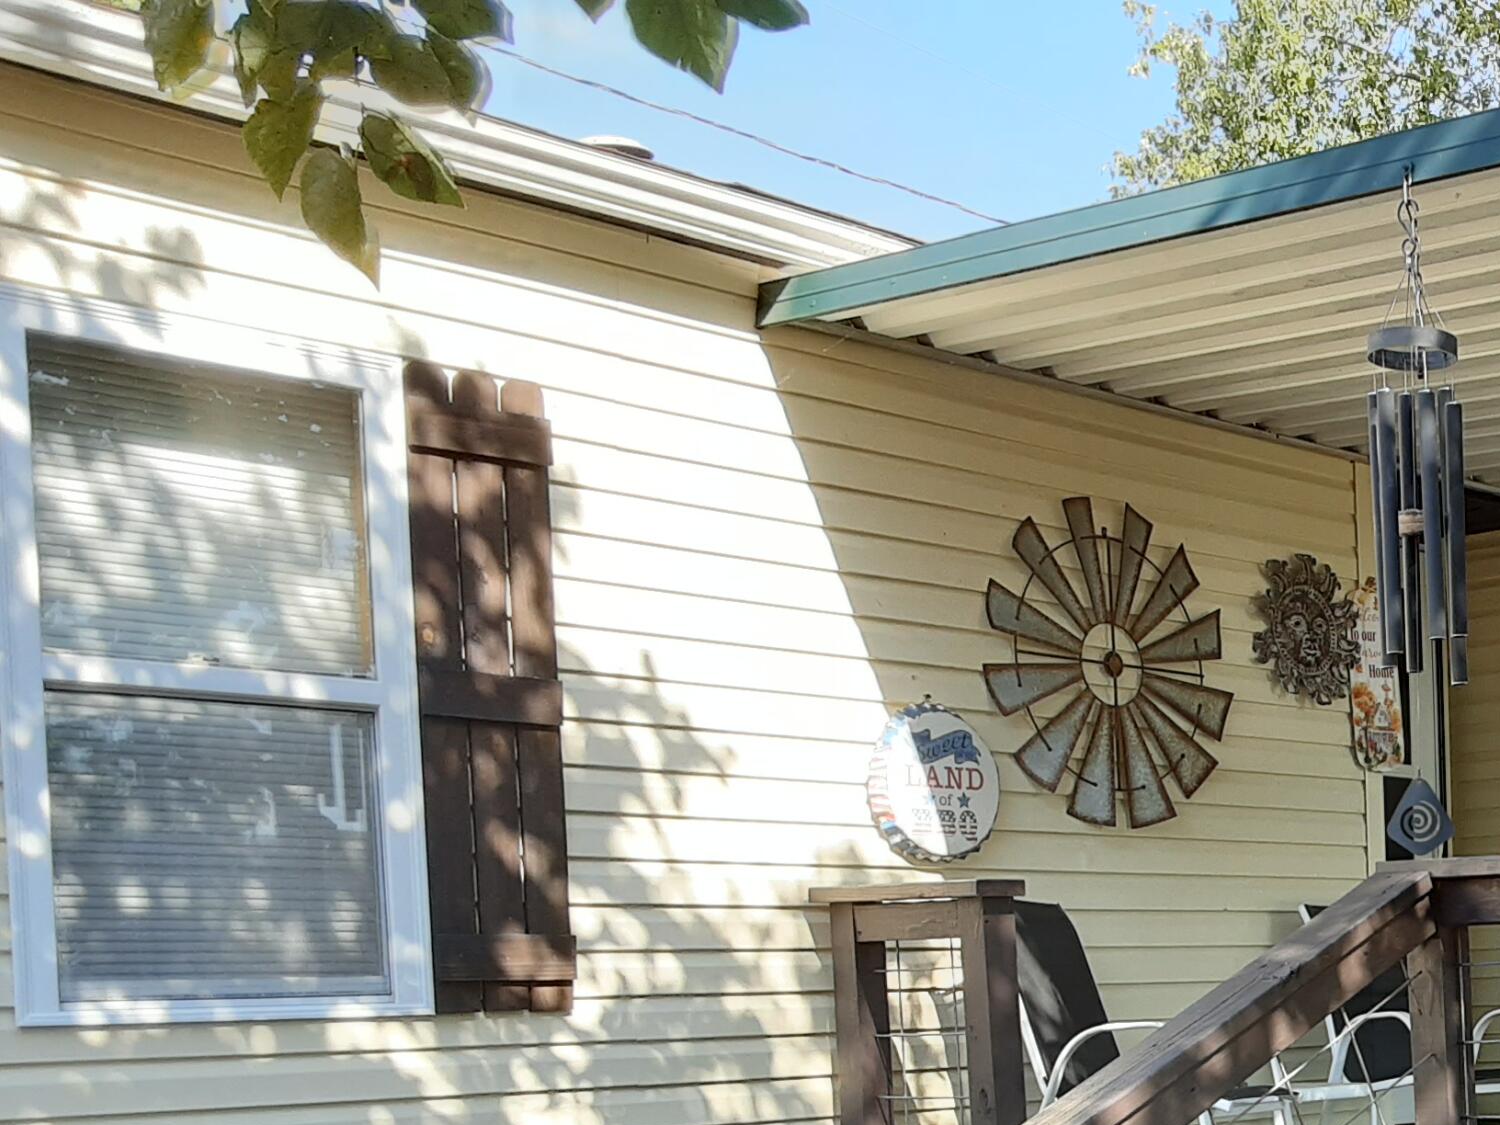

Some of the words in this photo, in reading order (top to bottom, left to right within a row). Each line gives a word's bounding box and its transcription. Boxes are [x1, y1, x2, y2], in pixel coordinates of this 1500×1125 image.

[1361, 631, 1376, 642] our
[1368, 664, 1395, 679] Home
[916, 732, 968, 760] Sweet
[905, 763, 985, 791] LAND
[938, 793, 954, 807] of
